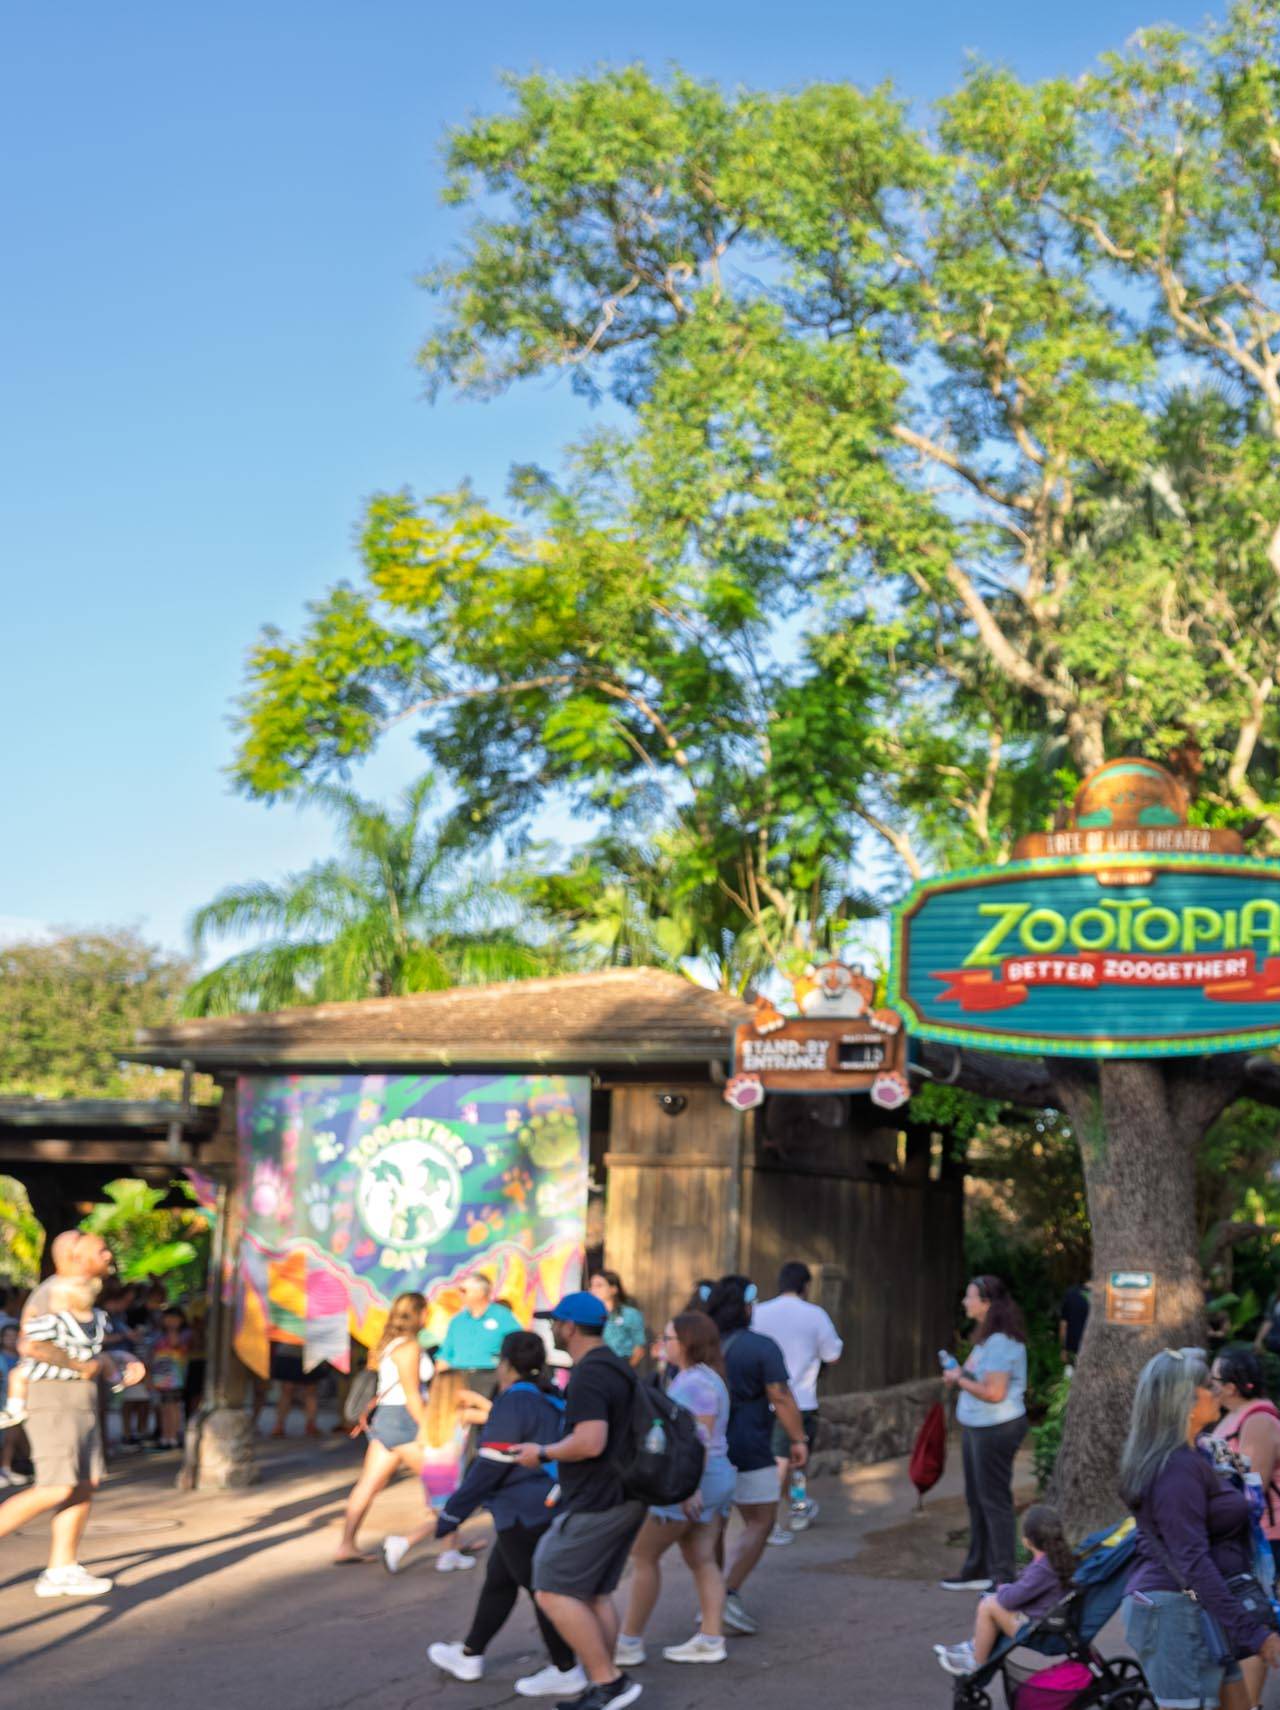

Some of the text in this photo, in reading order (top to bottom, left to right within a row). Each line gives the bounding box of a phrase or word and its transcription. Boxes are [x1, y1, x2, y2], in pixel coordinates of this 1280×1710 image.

[1147, 829, 1211, 850] THEATER
[1007, 957, 1248, 982] BETTER ZOOGETHER!
[742, 1039, 830, 1055] STAND-BY
[743, 1055, 826, 1071] ENTRANCE
